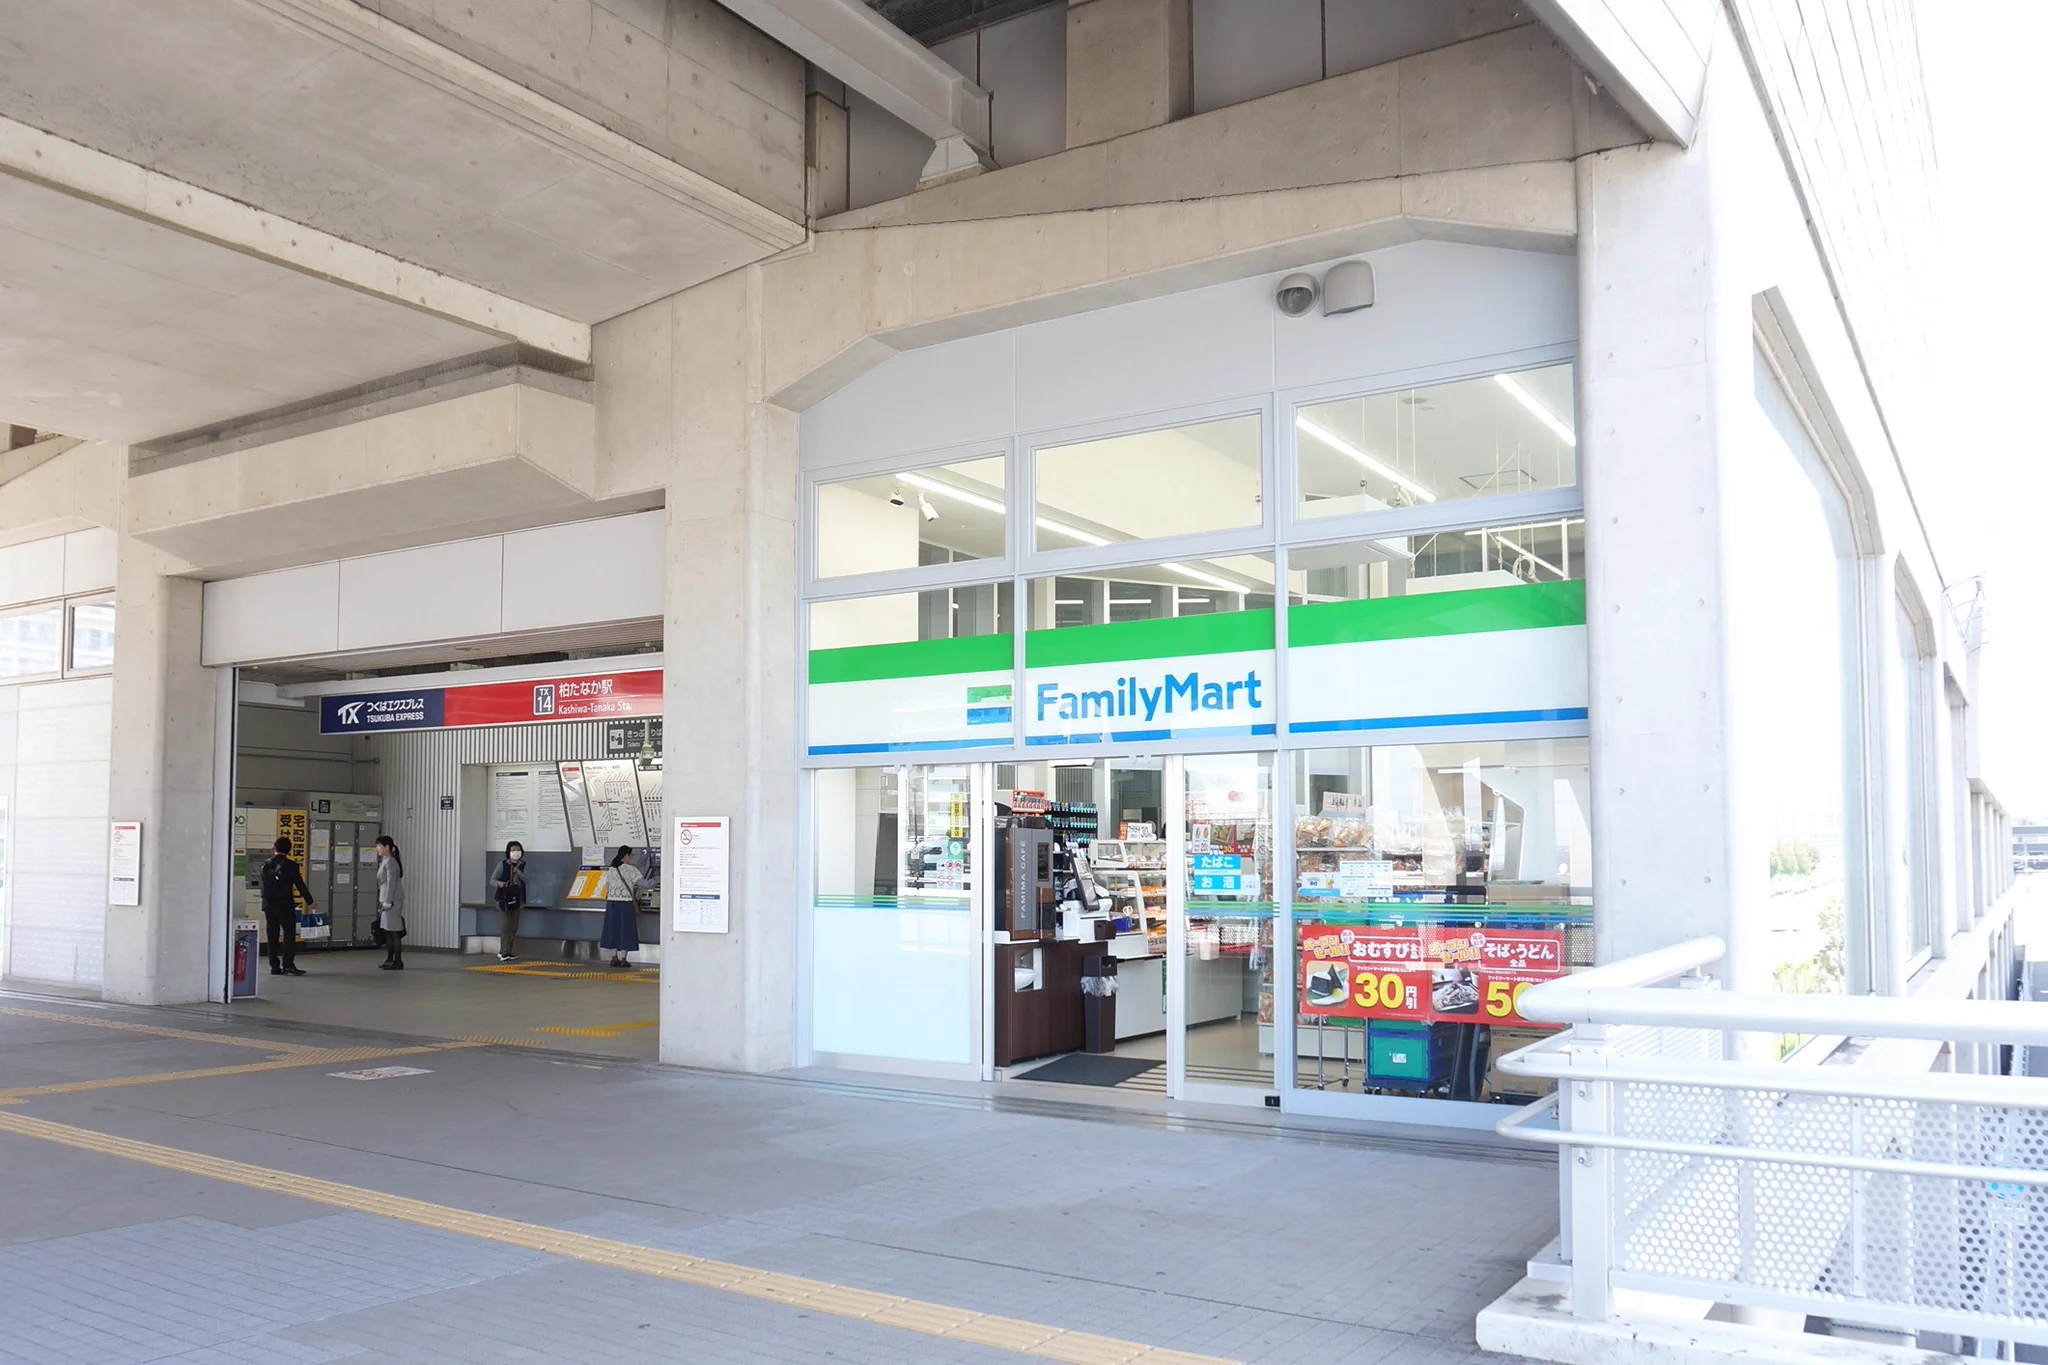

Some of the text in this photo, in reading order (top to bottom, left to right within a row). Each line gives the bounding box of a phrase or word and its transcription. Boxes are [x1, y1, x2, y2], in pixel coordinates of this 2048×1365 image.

[539, 688, 549, 696] TX
[558, 679, 613, 698] 柏たなか駅
[1037, 670, 1262, 722] FamilyMart
[366, 698, 424, 712] つくばエクスプレス
[537, 696, 552, 712] 14
[558, 701, 633, 715] Kashiwa-Tanaka Sta.
[366, 711, 424, 723] TSUKUBA EXPRESS
[627, 728, 663, 739] きっぷりば
[1201, 856, 1234, 868] たばこ
[1353, 941, 1410, 959] おむすび
[1484, 943, 1555, 960] そば・うどん
[1509, 959, 1527, 968] 全品
[1355, 972, 1405, 1009] 30
[1405, 985, 1417, 1010] 円引
